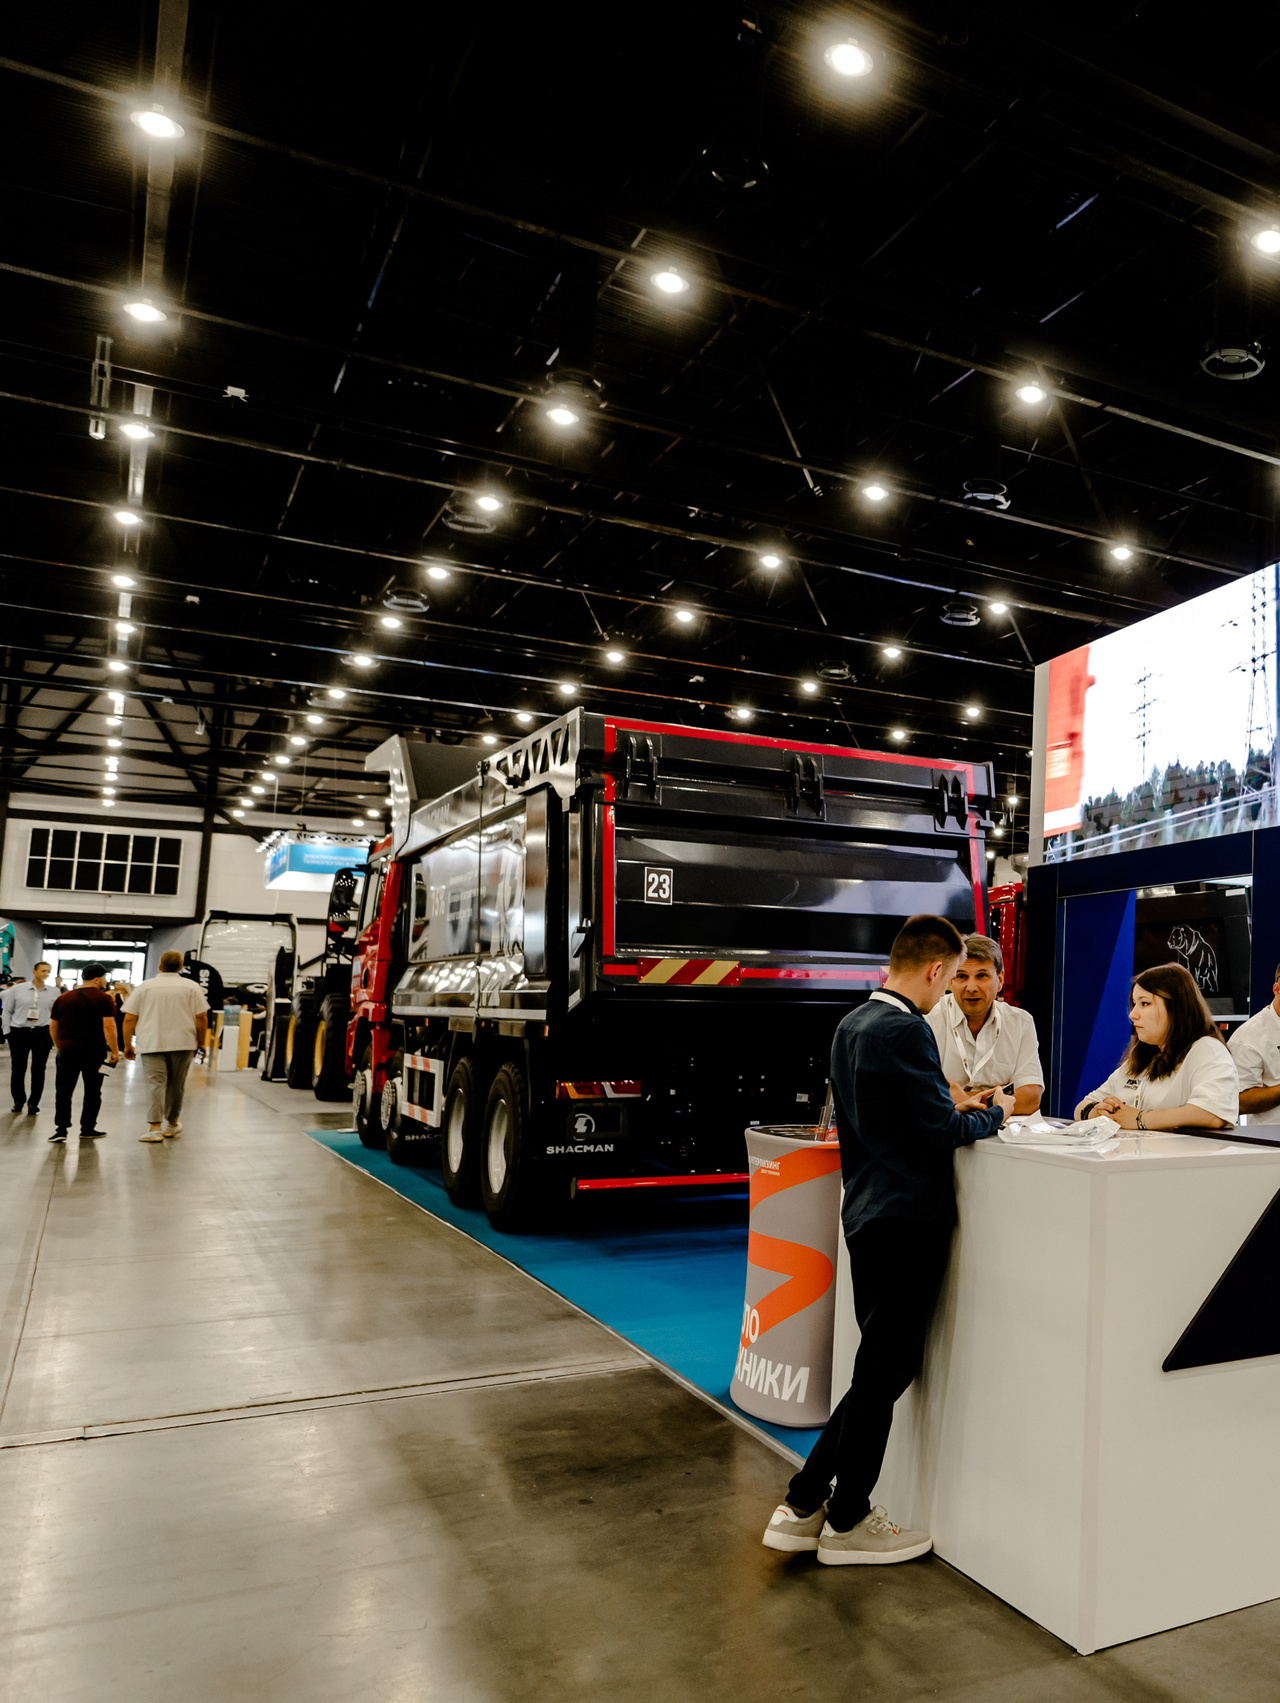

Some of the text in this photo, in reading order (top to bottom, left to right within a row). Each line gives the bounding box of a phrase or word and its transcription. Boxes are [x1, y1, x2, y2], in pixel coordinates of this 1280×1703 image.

[647, 872, 670, 899] 23
[546, 1144, 614, 1154] SHACMAN
[742, 1302, 760, 1343] ЛО
[735, 1342, 810, 1403] ХНИКИ
